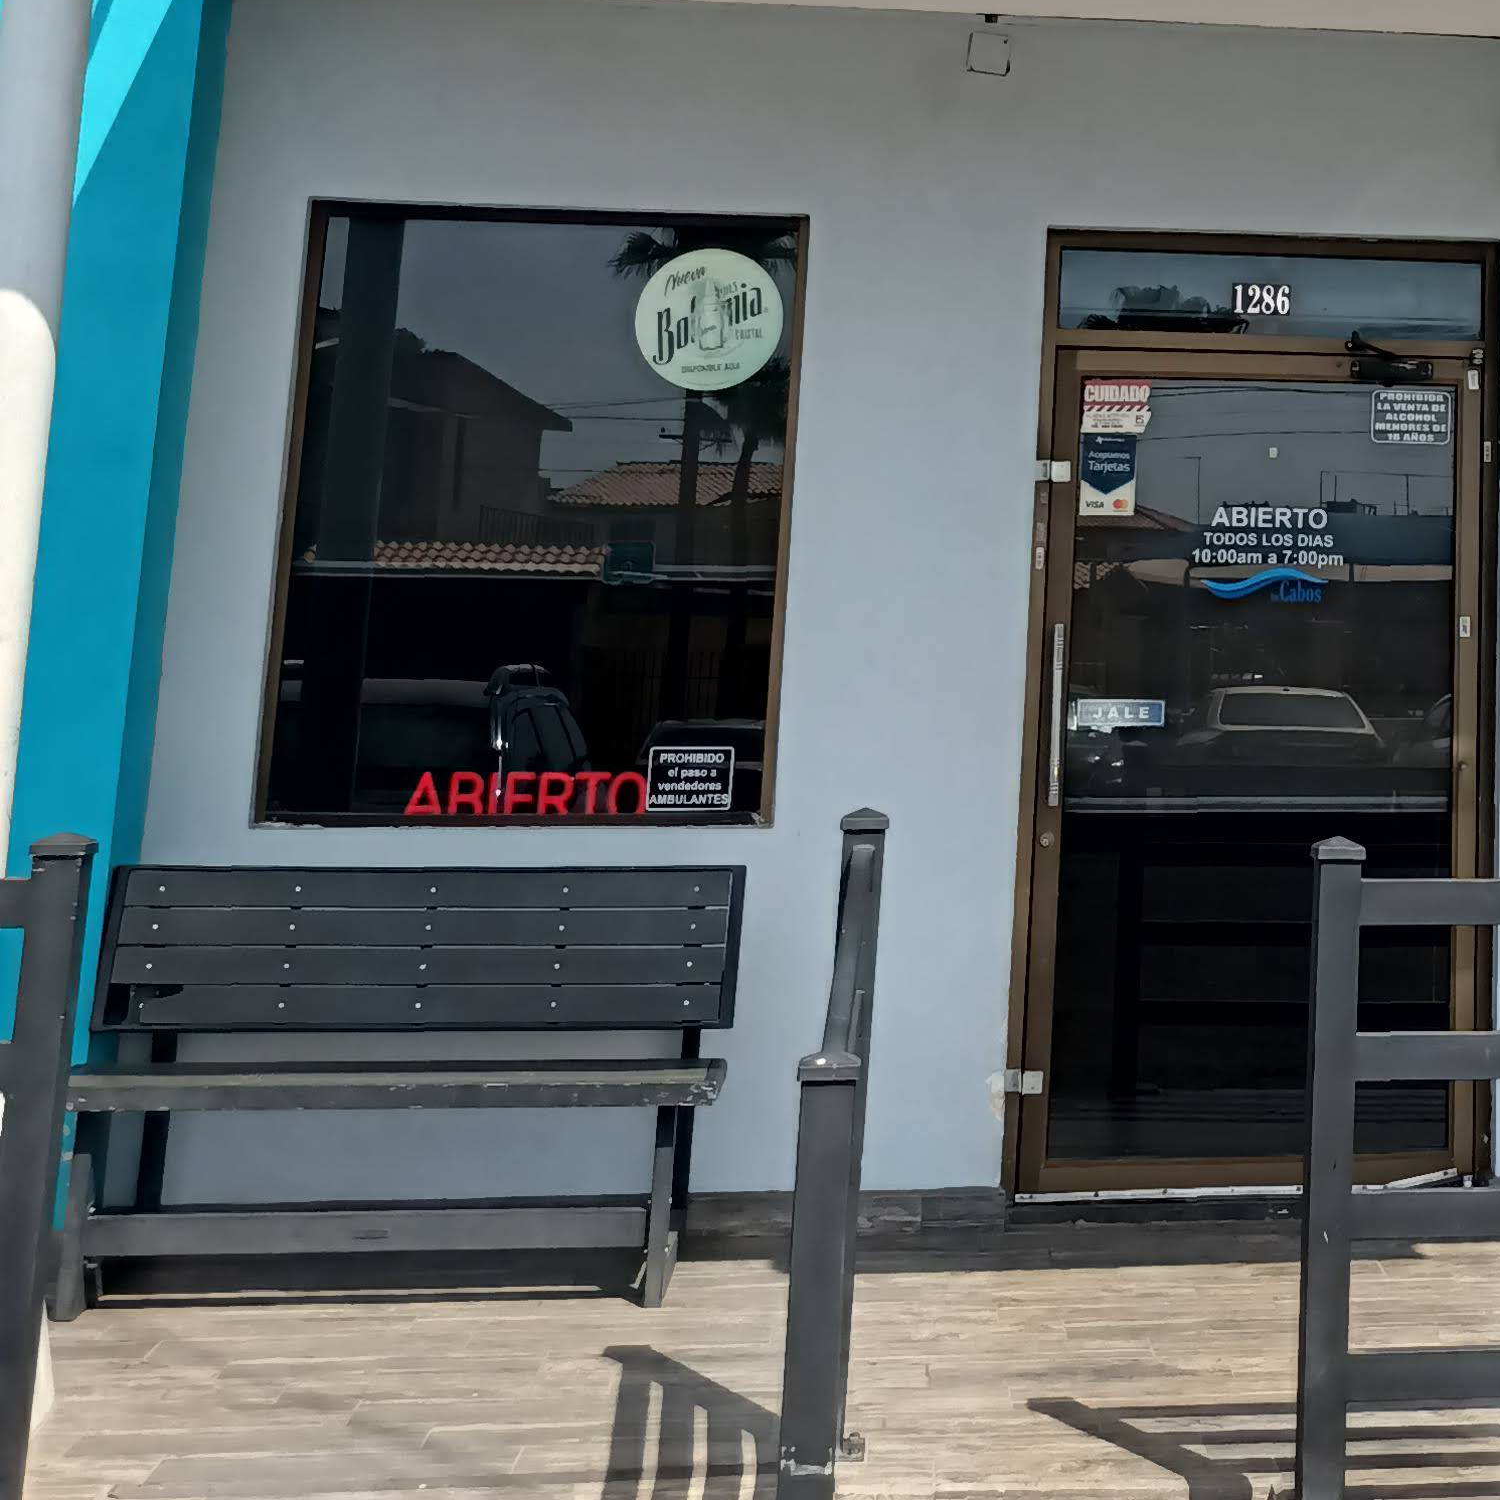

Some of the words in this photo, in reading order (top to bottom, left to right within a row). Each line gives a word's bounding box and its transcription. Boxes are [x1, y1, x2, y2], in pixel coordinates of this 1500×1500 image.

[1233, 284, 1290, 315] 1286
[1084, 385, 1150, 402] CUIDADO
[1380, 392, 1444, 402] PROHIBIDA
[1377, 402, 1391, 410] LA
[1393, 403, 1429, 411] VENTA
[1431, 404, 1446, 412] DE
[1385, 413, 1437, 422] ALCOHOL
[1375, 422, 1430, 432] MENORES
[1432, 424, 1447, 432] DE
[1388, 433, 1400, 441] 18
[1403, 432, 1434, 442] AÑOS
[1088, 461, 1131, 473] Tarjetas
[1085, 500, 1104, 509] VISA
[1211, 506, 1328, 529] ABIERTO
[1203, 532, 1257, 546] TODOS
[1262, 533, 1293, 547] LOS
[1298, 534, 1334, 548] DIAS
[1192, 548, 1262, 564] 10:00am
[1268, 552, 1278, 565] a
[1282, 550, 1344, 569] 7:00pm
[1280, 580, 1322, 602] Cabos
[1093, 706, 1150, 719] JALE
[660, 753, 725, 764] PROHIBIDO
[667, 766, 679, 777] el
[681, 769, 708, 779] paso
[710, 769, 717, 777] a
[658, 780, 722, 791] vendedores
[649, 794, 729, 805] AMBULANTES
